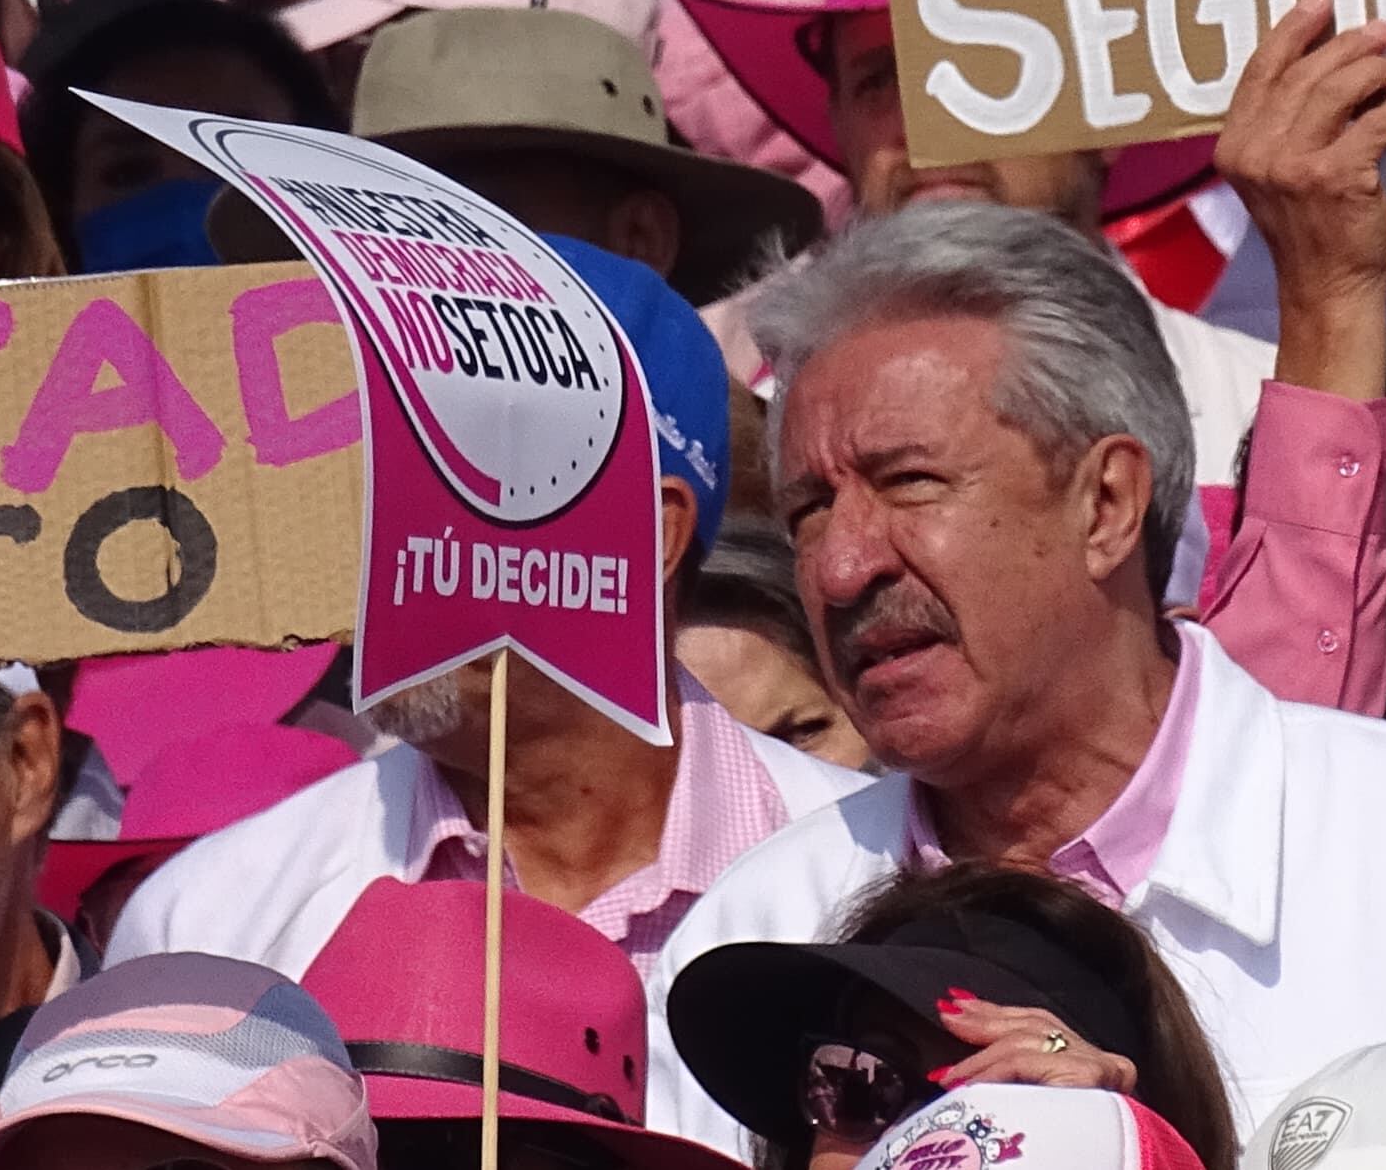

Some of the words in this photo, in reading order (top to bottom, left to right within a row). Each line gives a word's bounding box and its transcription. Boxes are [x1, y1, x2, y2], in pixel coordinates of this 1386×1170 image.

[267, 175, 510, 251] #NUESTRA
[331, 228, 557, 306] DEMOCRACIA
[393, 526, 462, 607] ¡TÚ
[471, 541, 629, 615] DECIDE!
[42, 1053, 159, 1083] orca
[1281, 1110, 1336, 1138] EA7
